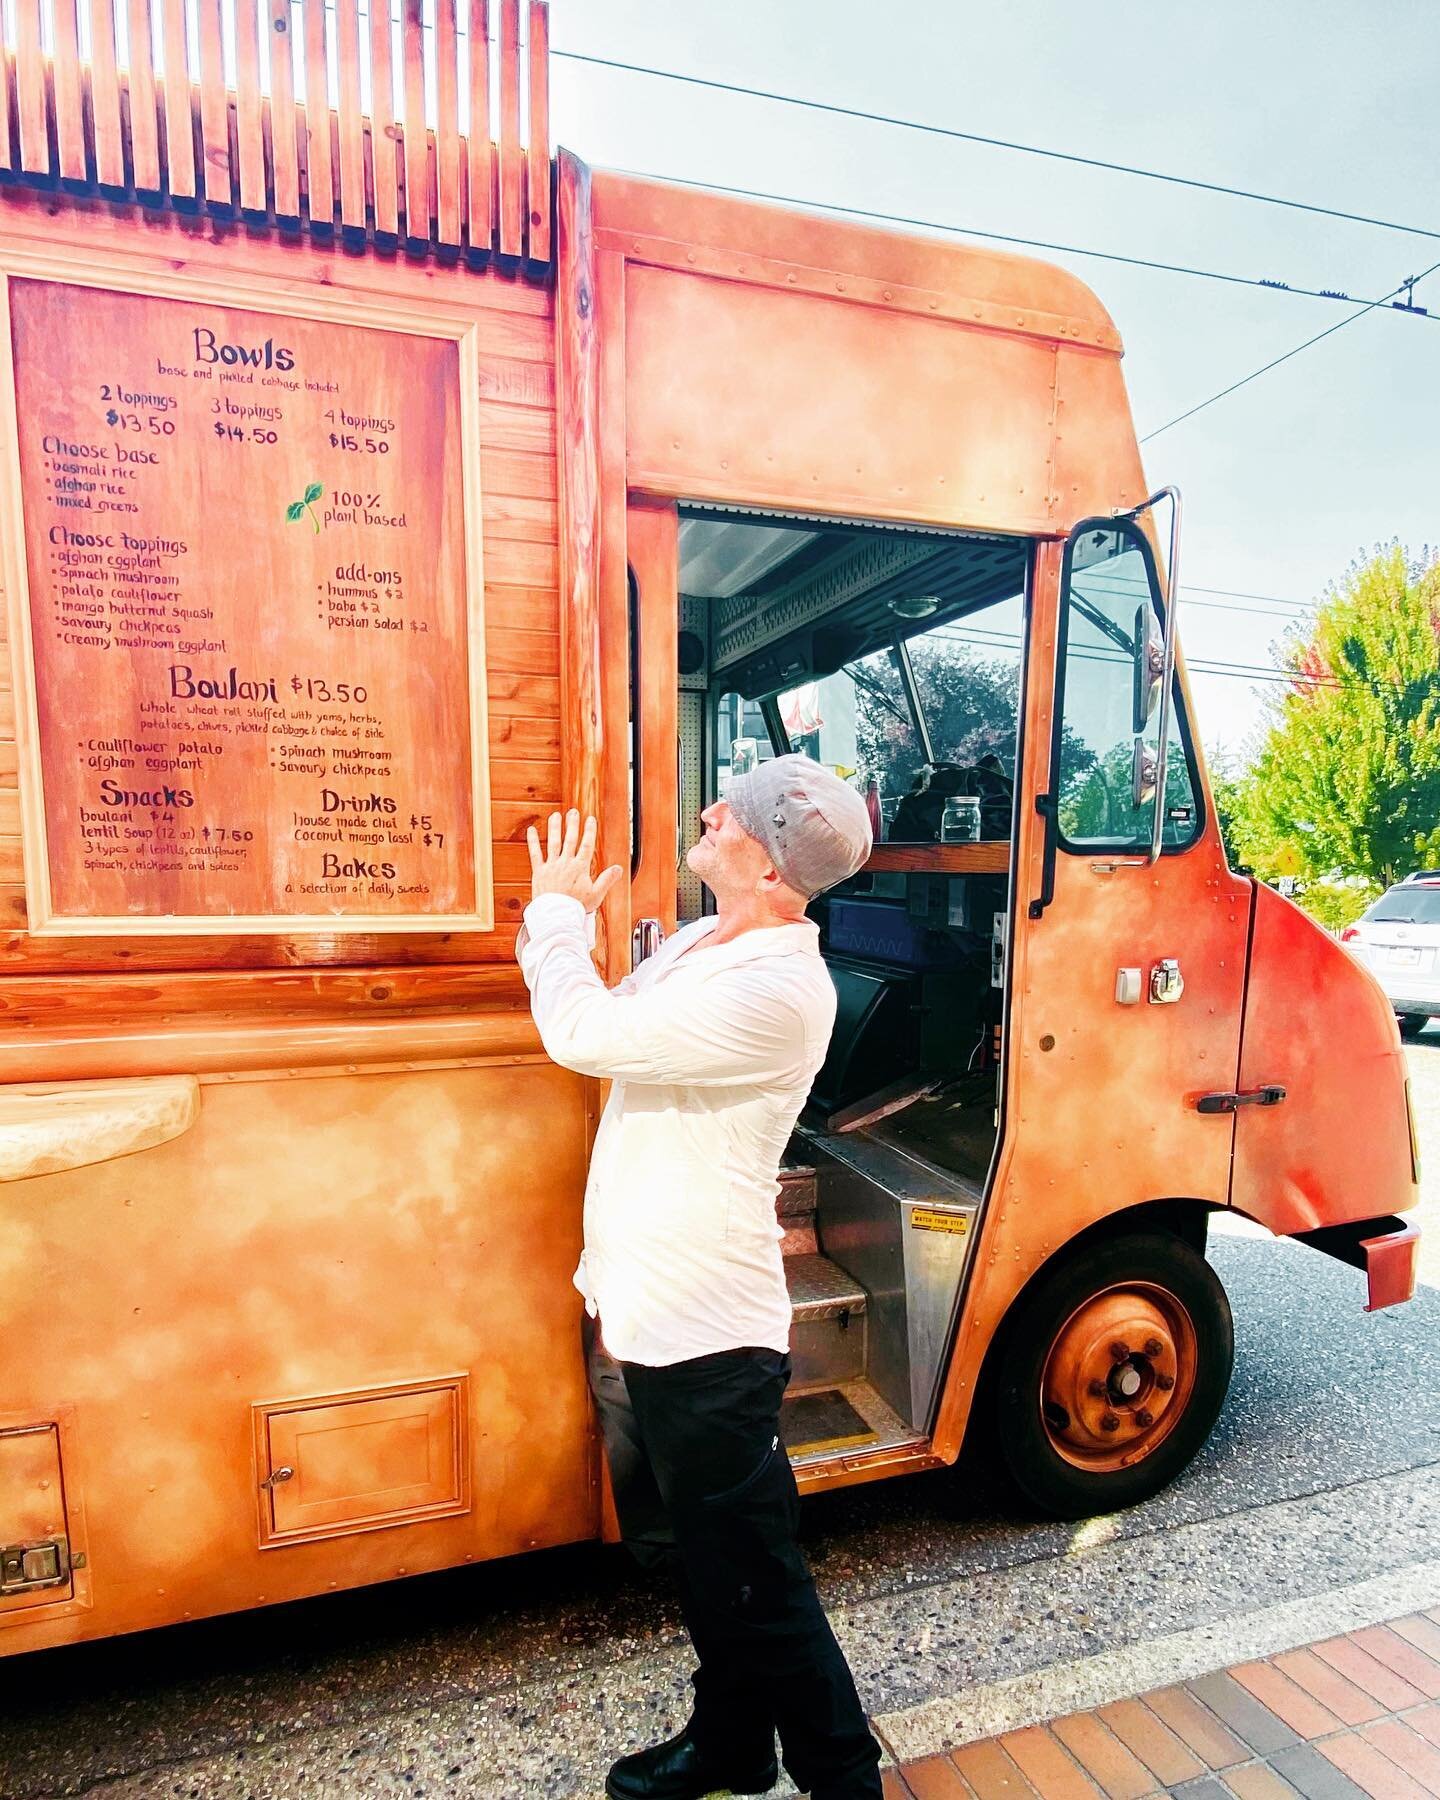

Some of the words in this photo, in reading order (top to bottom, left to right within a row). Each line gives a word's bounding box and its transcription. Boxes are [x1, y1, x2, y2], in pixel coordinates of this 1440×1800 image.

[192, 328, 295, 371] Bowls
[157, 359, 188, 377] base
[194, 367, 212, 380] and
[219, 372, 253, 384] pickled
[261, 377, 300, 390] cabbage
[304, 379, 339, 393] included
[100, 385, 112, 400] 2
[117, 384, 177, 411] toppings
[211, 398, 221, 413] 3
[225, 397, 283, 421] toppings
[324, 410, 335, 424] 4
[340, 408, 395, 434] toppings
[214, 421, 278, 444] $14.50
[43, 435, 110, 459] Choose
[115, 442, 160, 464] base
[329, 433, 389, 453] $15.50
[52, 458, 106, 477] basmati
[112, 467, 137, 479] rice
[55, 476, 96, 493] afghan
[100, 483, 126, 495] rice
[55, 495, 92, 509] mixed
[93, 500, 138, 513] greens
[332, 491, 381, 508] 100%
[324, 508, 357, 529] plant
[364, 509, 408, 528] based
[49, 526, 115, 548] Choose
[120, 532, 188, 558] toppings
[58, 549, 103, 566] afghan
[107, 555, 162, 571] eggplant
[113, 571, 179, 586] mushroom
[336, 563, 402, 585] add-ons
[61, 584, 104, 598] potato
[328, 582, 378, 599] hummus
[62, 602, 104, 616] mango
[109, 601, 166, 616] butternut
[172, 608, 214, 622] squash
[328, 599, 356, 612] baba
[328, 615, 369, 630] persian
[374, 617, 403, 630] salad
[114, 636, 174, 649] mushroom
[175, 639, 226, 654] eggplant
[168, 663, 279, 704] Boulani
[291, 675, 367, 703] $13.50
[187, 704, 218, 715] wheat
[247, 707, 286, 722] stuffed
[291, 710, 312, 719] with
[235, 723, 268, 736] pickled
[272, 724, 309, 737] cabbage
[352, 727, 360, 740] of
[332, 747, 392, 760] mushroom
[88, 754, 135, 772] afghan
[145, 757, 203, 772] eggplant
[100, 779, 194, 808] Snacks
[320, 788, 397, 814] Drinks
[79, 807, 133, 823] boulani
[294, 813, 331, 826] house
[336, 815, 368, 828] made
[373, 816, 397, 829] chai
[410, 814, 432, 830] $5
[81, 825, 119, 839] lentil
[349, 833, 384, 845] mango
[423, 833, 444, 848] $7
[97, 842, 129, 857] types
[135, 844, 145, 856] of
[129, 860, 183, 872] chickpeas
[188, 861, 205, 871] and
[321, 852, 396, 879] Bakes
[352, 883, 363, 897] of
[368, 883, 394, 899] daily
